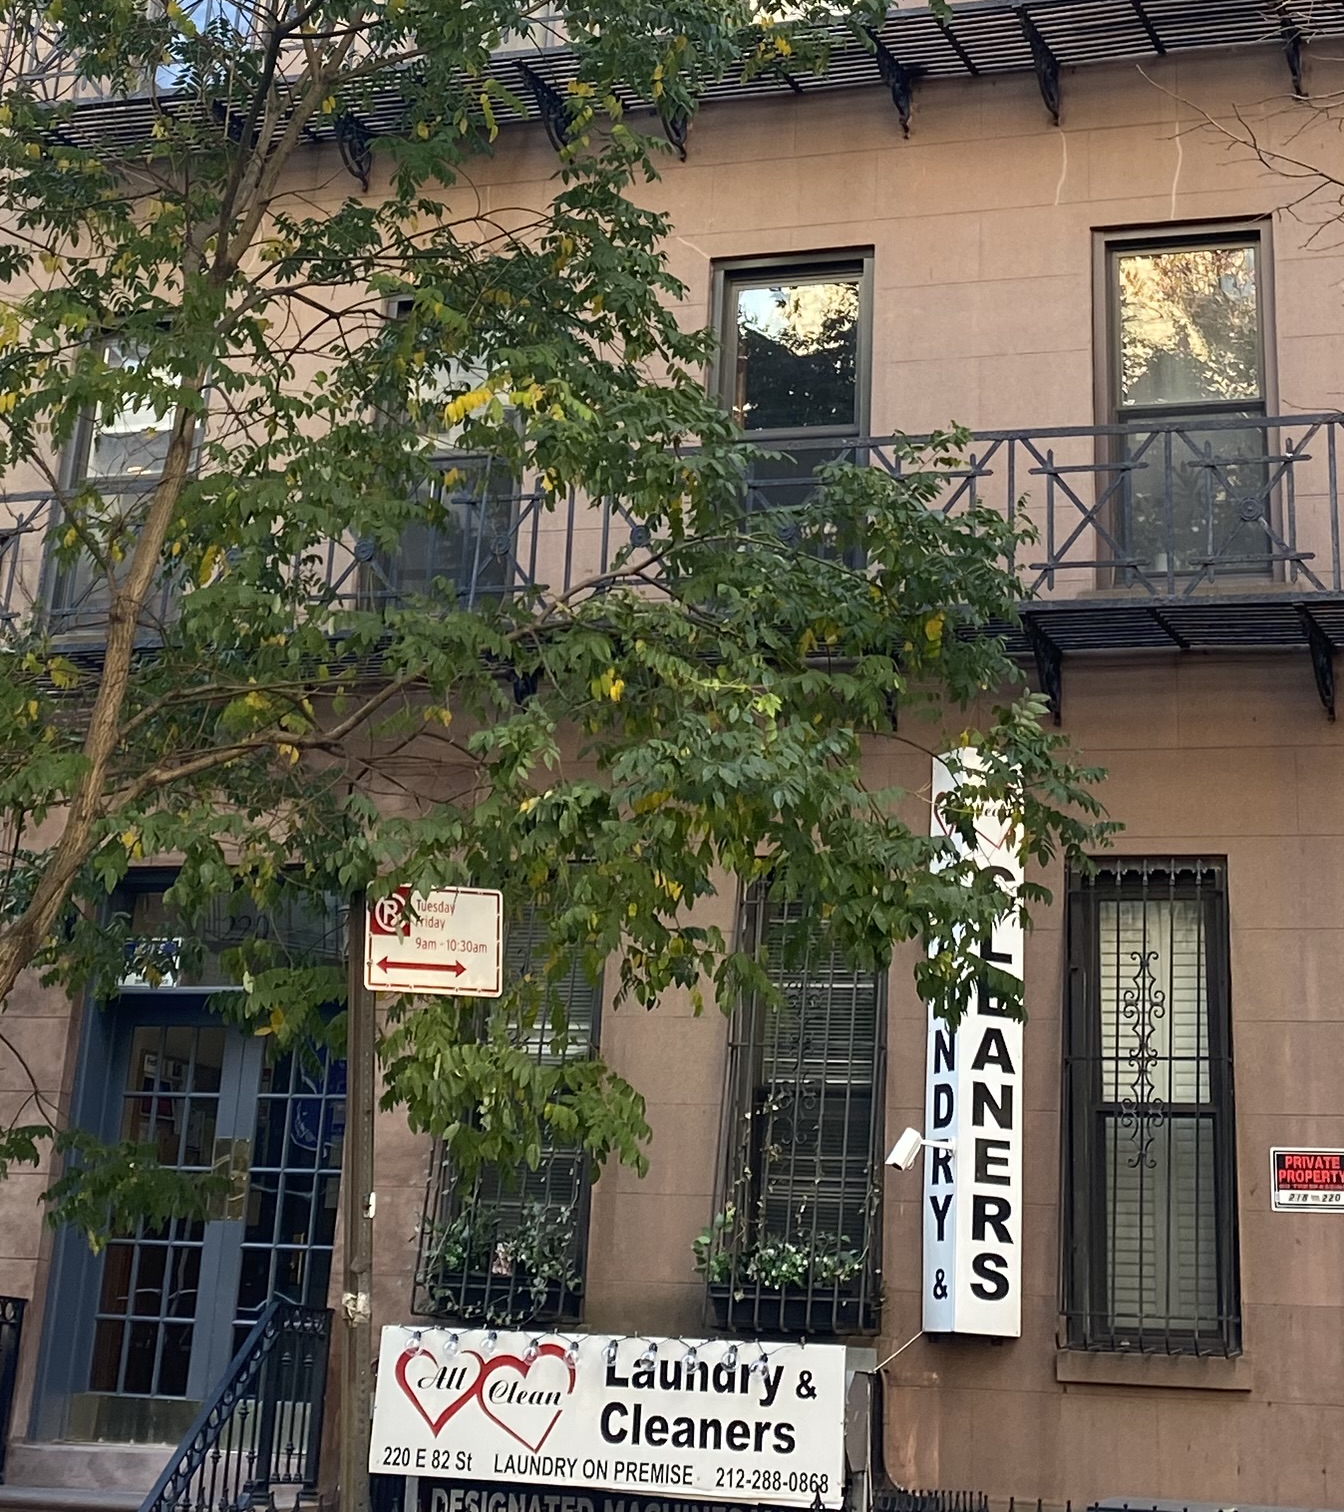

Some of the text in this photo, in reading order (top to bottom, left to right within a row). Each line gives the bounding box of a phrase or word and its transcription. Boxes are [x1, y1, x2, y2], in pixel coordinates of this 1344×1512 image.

[416, 899, 456, 915] Tuesday
[415, 937, 437, 950] 9am
[446, 939, 488, 954] 10:30am
[1284, 1155, 1341, 1169] PRIVATE
[1321, 1193, 1341, 1203] 220
[933, 1268, 949, 1301] &
[417, 1365, 563, 1406] All Clean
[605, 1348, 818, 1407] Laundry &
[600, 1401, 797, 1455] Cleaners
[382, 1446, 830, 1494] 220 E 82 St LAUNDRY ON PREMISE 212-288-0868
